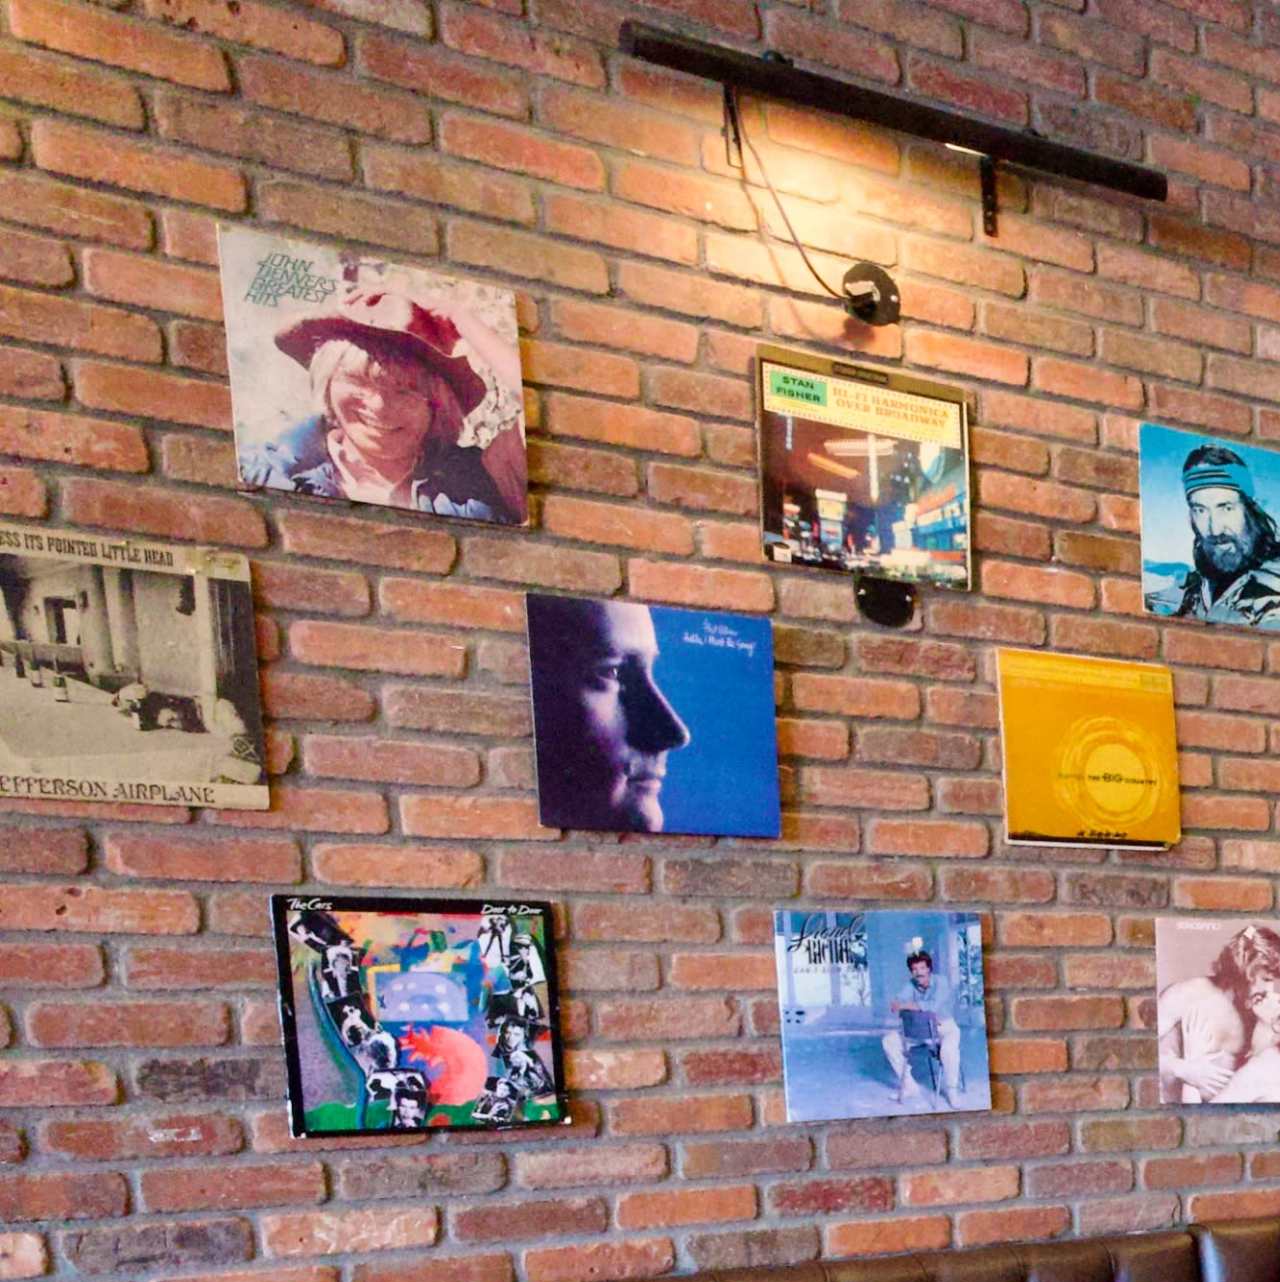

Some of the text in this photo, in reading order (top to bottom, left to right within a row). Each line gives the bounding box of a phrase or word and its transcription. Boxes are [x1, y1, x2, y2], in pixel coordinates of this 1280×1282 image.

[782, 375, 815, 390] STAN
[24, 533, 175, 568] ITS POINTED LITTLE HEAD
